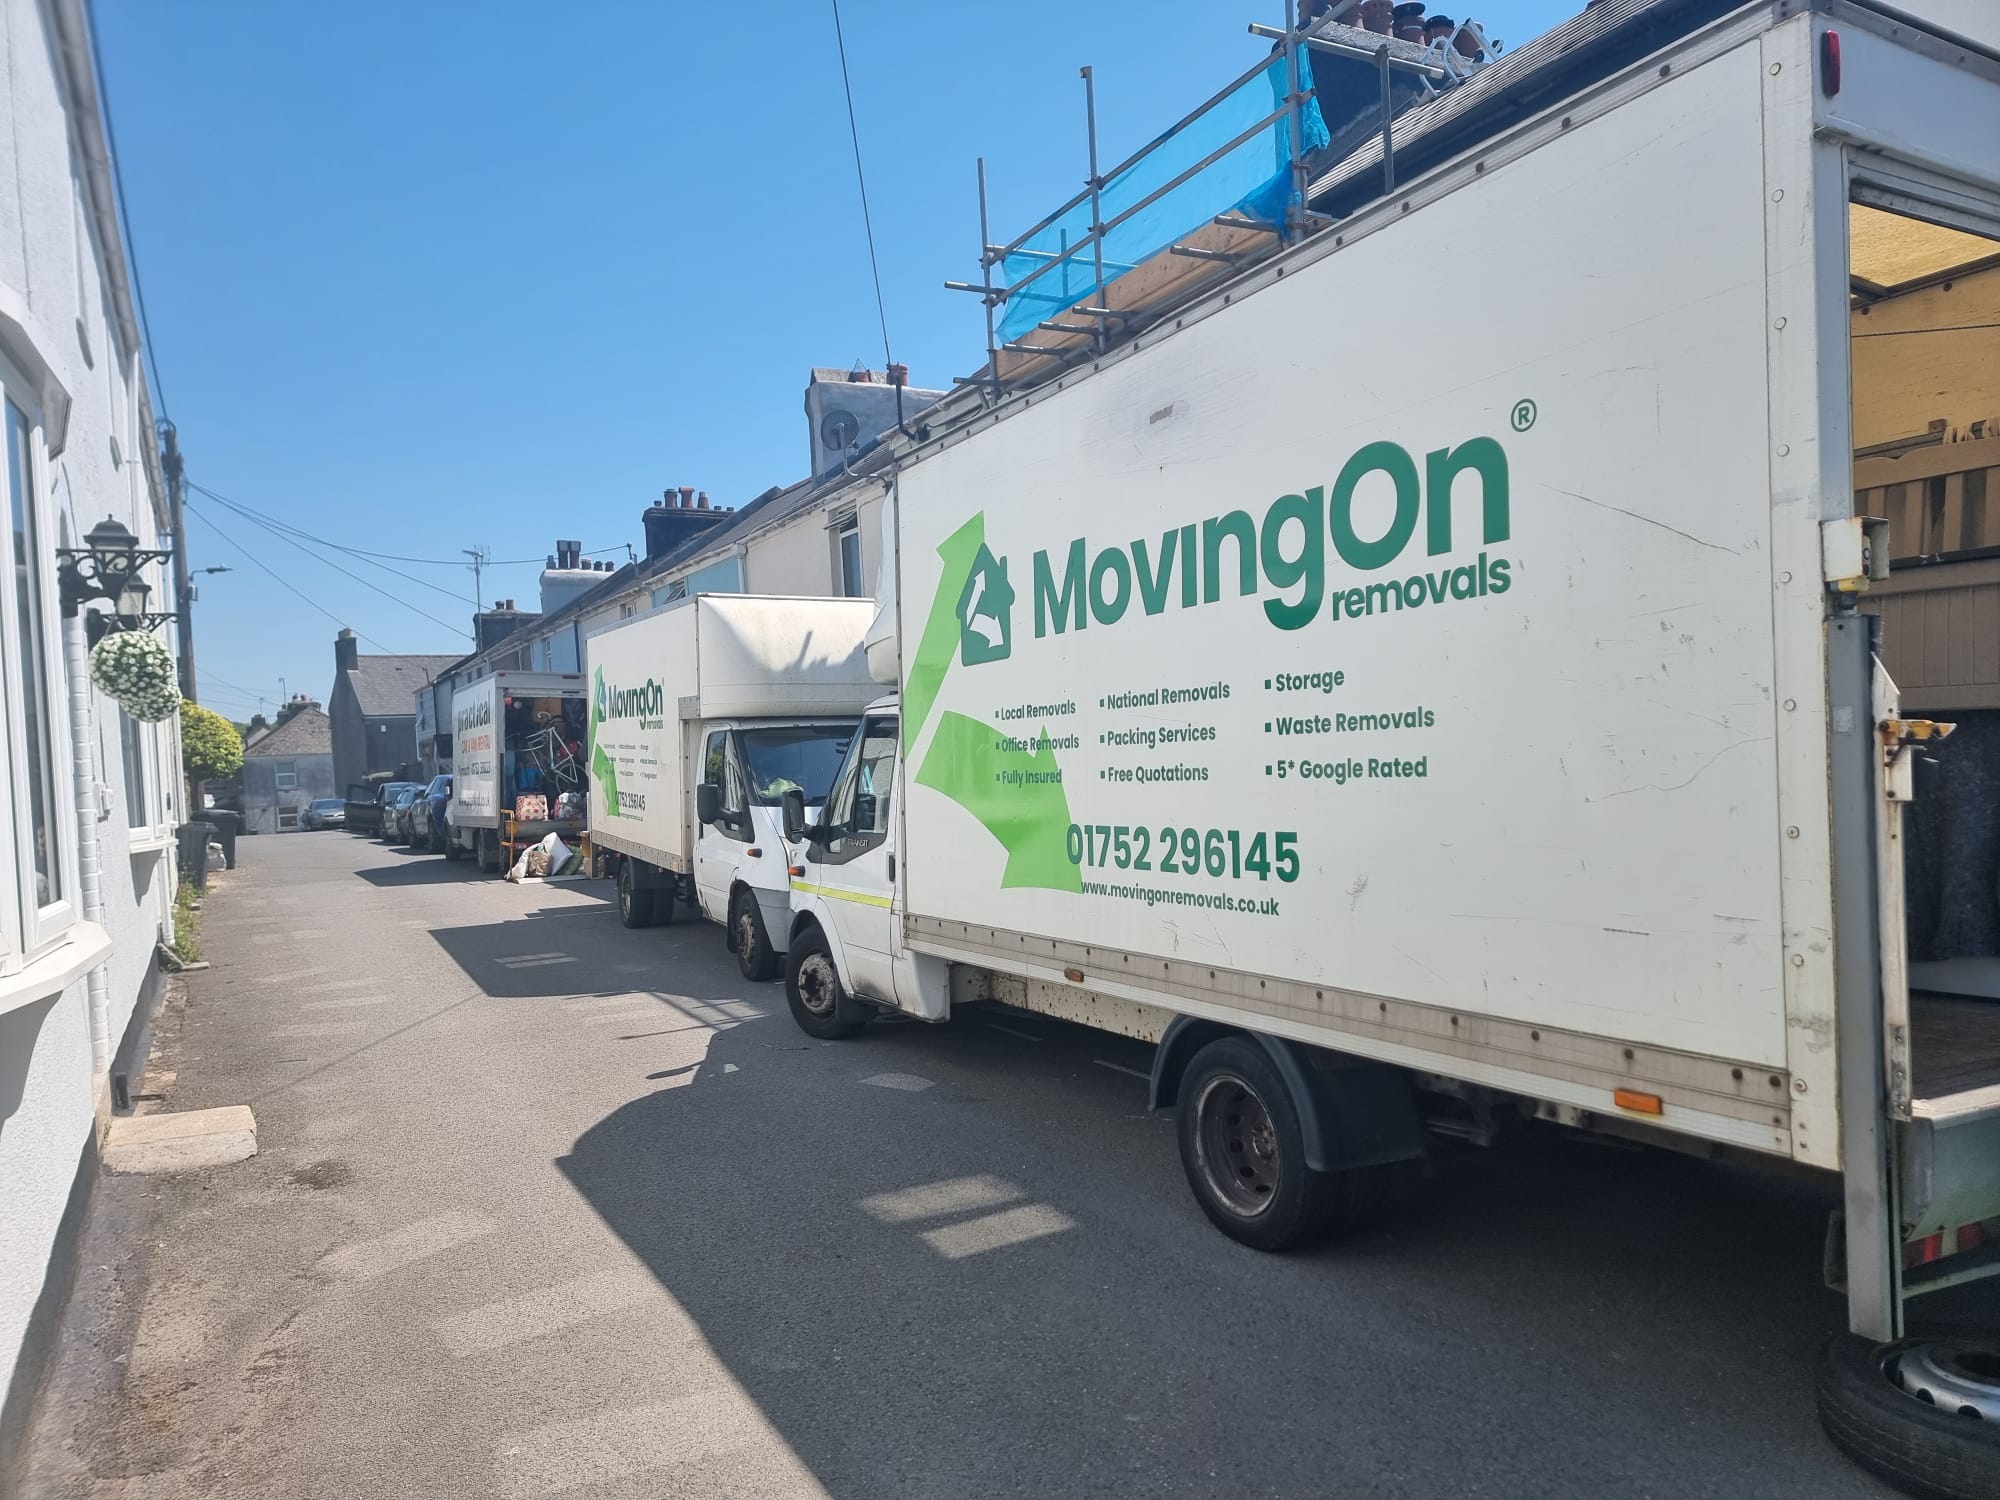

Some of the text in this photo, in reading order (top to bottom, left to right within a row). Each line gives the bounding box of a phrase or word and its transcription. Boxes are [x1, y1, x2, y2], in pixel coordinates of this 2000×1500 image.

[1033, 436, 1510, 639] MovingOn
[1332, 552, 1512, 621] removals
[1107, 681, 1230, 710] National Removals
[1276, 670, 1345, 694] Storage
[608, 678, 663, 731] MovingOn
[1001, 699, 1076, 720] Local Removals
[1276, 706, 1435, 735] Waste Removals
[1001, 733, 1080, 752] Office Removals
[1107, 723, 1216, 749] Packing Services
[1002, 768, 1062, 789] Fully Insured
[1108, 763, 1209, 784] Free Quotations
[1300, 758, 1364, 785] Google
[1368, 756, 1428, 778] Rated
[1067, 823, 1300, 883] 01752 296145
[1081, 881, 1280, 916] www.movingonremovals.co.uk
